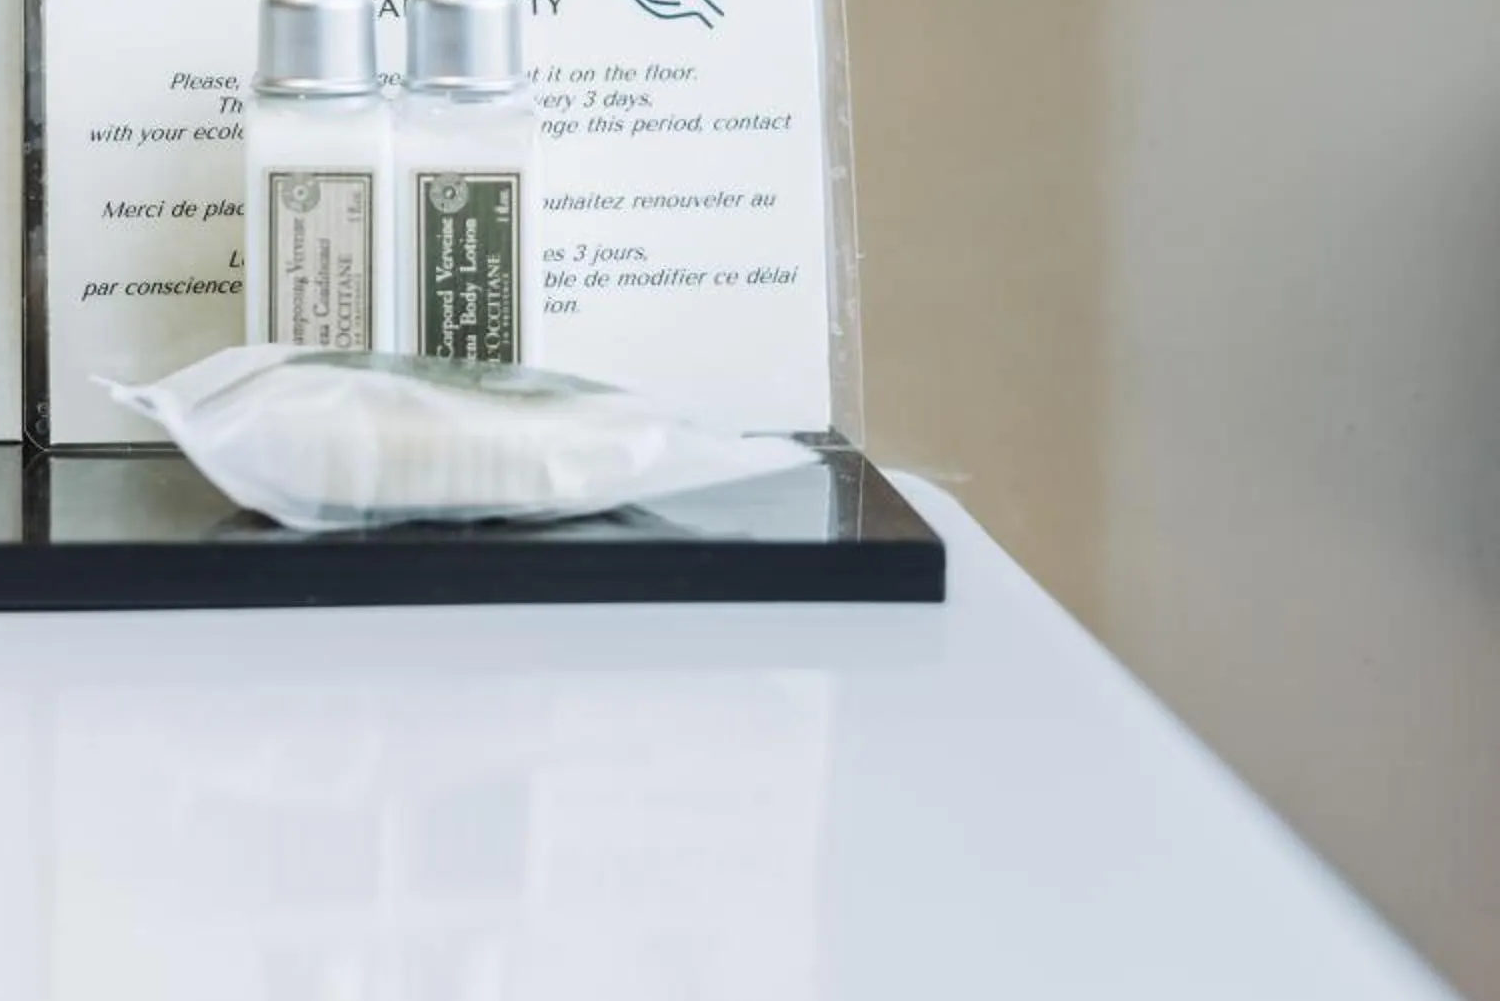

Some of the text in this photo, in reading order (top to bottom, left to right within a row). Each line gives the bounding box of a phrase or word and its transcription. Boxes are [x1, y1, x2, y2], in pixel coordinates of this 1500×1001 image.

[170, 72, 240, 91] Please,
[570, 68, 595, 83] on
[604, 65, 636, 83] the
[583, 90, 596, 108] 3
[587, 115, 624, 134] this
[713, 112, 792, 131] contact
[90, 123, 133, 142] with
[137, 126, 188, 146] your
[101, 200, 165, 218] Merci
[171, 200, 197, 218] de
[631, 190, 743, 210] renouveler
[750, 192, 777, 207] au
[436, 216, 454, 282] Verveine
[459, 217, 478, 273] Lotion
[572, 244, 587, 262] 3
[583, 270, 610, 287] de
[617, 268, 708, 287] modifier
[713, 270, 740, 285] ce
[746, 265, 799, 285] délai
[81, 277, 243, 301] par conscience
[460, 282, 482, 326] Body
